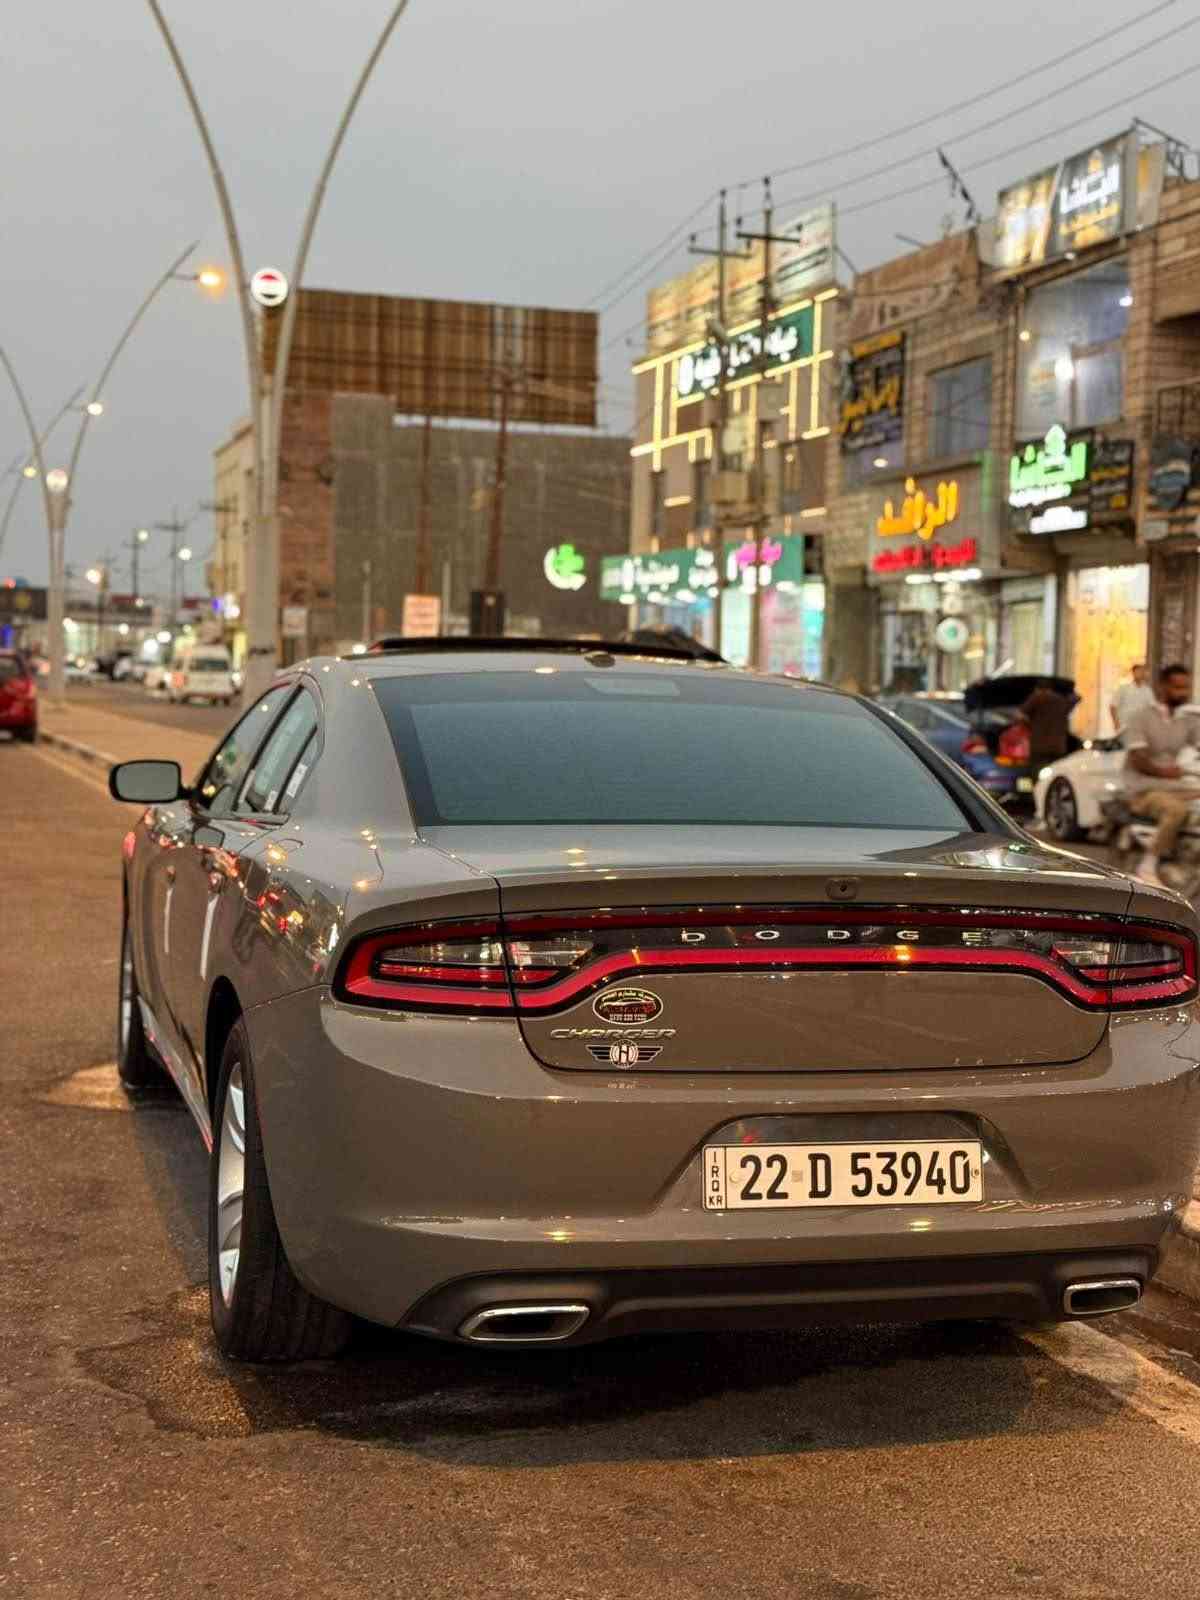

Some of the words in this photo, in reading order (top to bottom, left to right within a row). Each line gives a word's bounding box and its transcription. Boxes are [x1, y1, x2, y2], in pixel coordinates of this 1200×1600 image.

[681, 927, 983, 943] DODGE
[550, 1028, 677, 1039] CHARGER
[740, 1154, 789, 1201] 22
[808, 1153, 832, 1199] D
[851, 1150, 971, 1197] 53940
